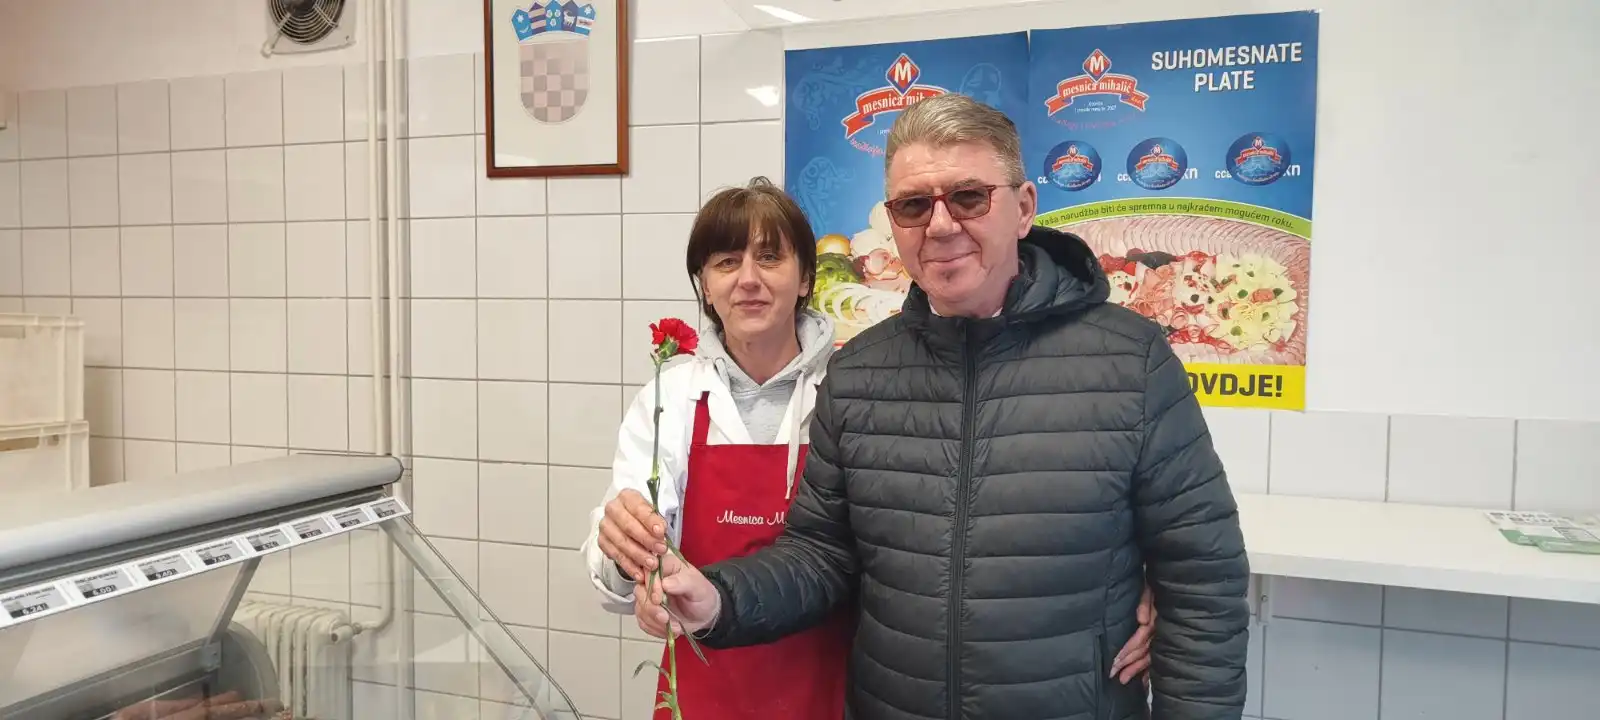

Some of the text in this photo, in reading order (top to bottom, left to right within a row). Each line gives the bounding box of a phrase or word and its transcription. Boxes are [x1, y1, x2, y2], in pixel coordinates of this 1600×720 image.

[1089, 55, 1105, 73] M
[1151, 42, 1302, 70] SUHOMESNATE
[894, 61, 912, 83] M
[1194, 70, 1255, 92] PLATE
[1062, 79, 1131, 97] mesnica mihalić
[862, 93, 904, 114] mesnica
[1060, 207, 1099, 221] narudžba
[1101, 204, 1115, 214] biti
[1129, 202, 1167, 213] spremna
[1176, 202, 1223, 213] najkraćem
[1225, 207, 1269, 222] mogućem
[1271, 216, 1294, 229] roku.
[716, 510, 786, 526] Mesnica M
